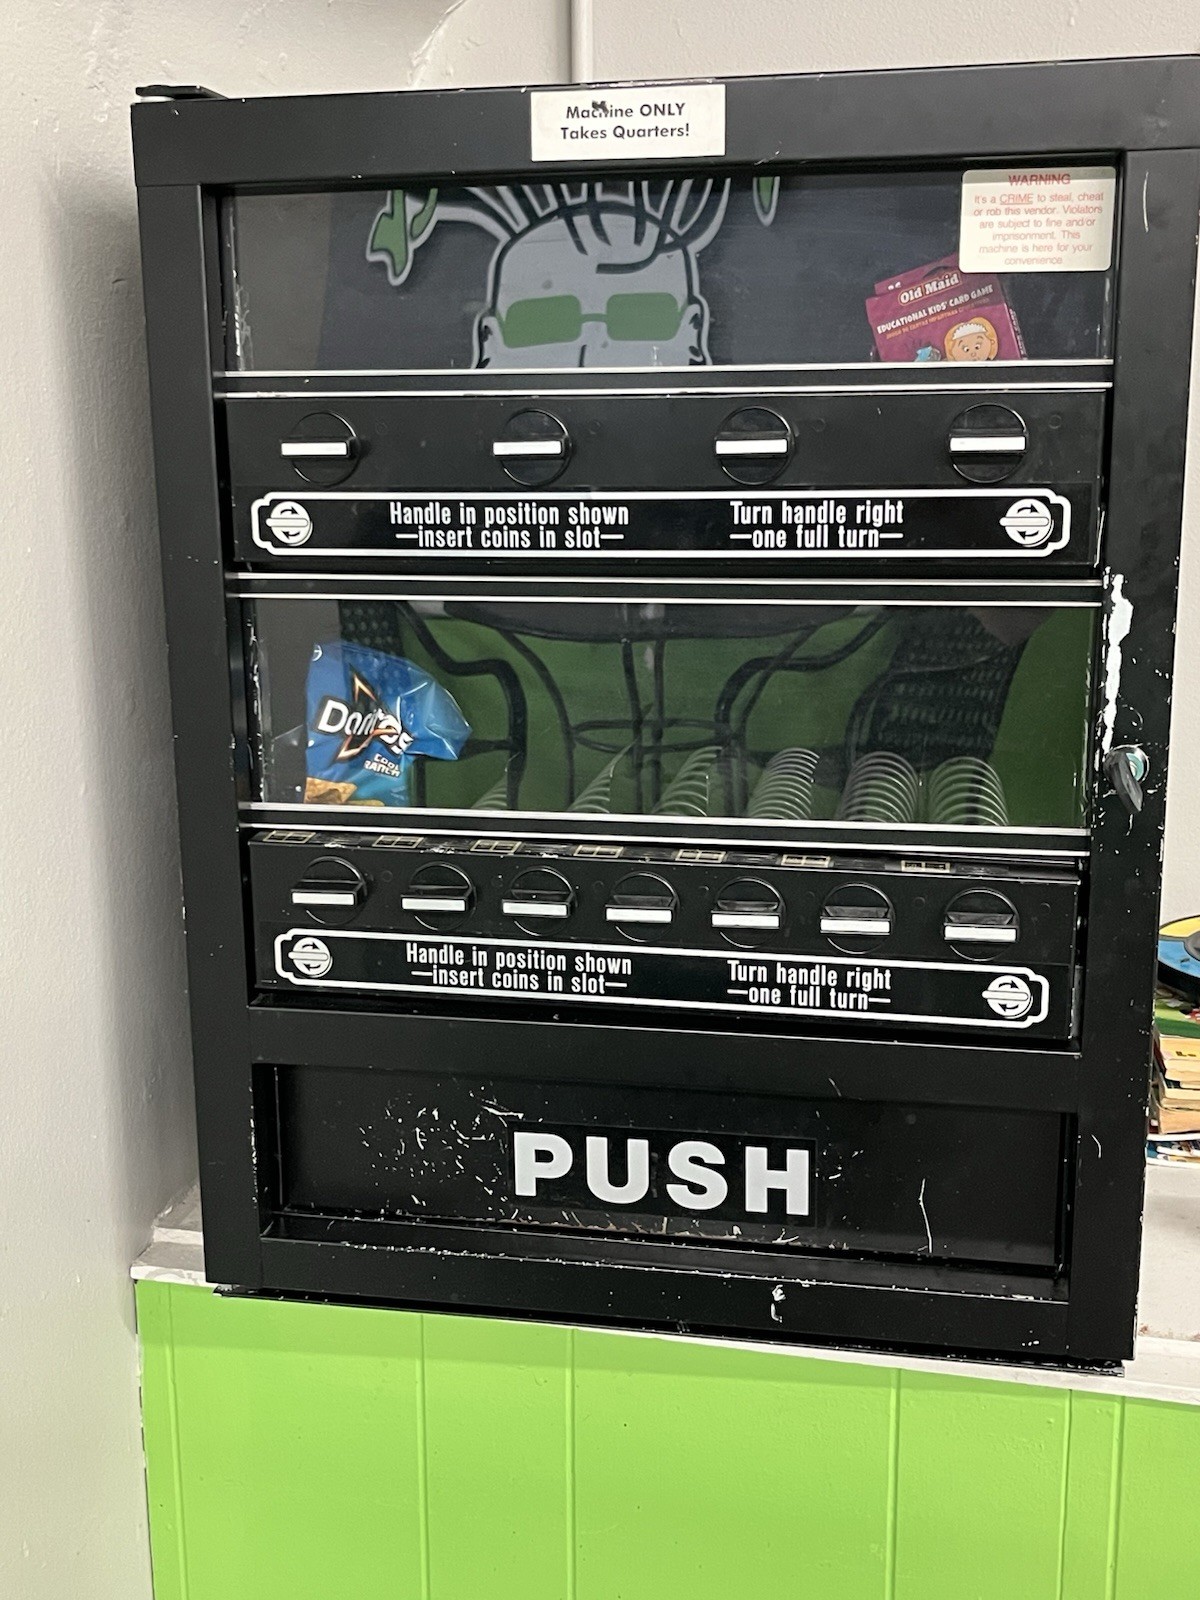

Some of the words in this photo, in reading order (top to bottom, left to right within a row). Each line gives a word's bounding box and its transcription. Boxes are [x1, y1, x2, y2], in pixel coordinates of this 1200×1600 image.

[640, 102, 686, 116] ONLY
[560, 126, 608, 140] Takes
[612, 123, 690, 139] Quarters!
[1008, 173, 1071, 186] WARNING
[975, 194, 988, 204] It's
[990, 196, 996, 204] a
[1000, 194, 1034, 204] CRIME
[1037, 194, 1046, 202] to
[1050, 193, 1073, 203] steal,
[1078, 192, 1104, 202] cheat
[974, 208, 982, 216] or
[986, 206, 1002, 216] rob
[1004, 206, 1020, 216] this
[1024, 206, 1058, 216] vendor.
[1062, 204, 1102, 214] Violators
[979, 220, 994, 229] are
[998, 218, 1030, 230] subject
[1034, 218, 1042, 228] to
[1046, 218, 1062, 227] fine
[1066, 218, 1096, 227] and/or
[1062, 230, 1081, 239] This
[979, 244, 1018, 254] machine
[1022, 244, 1029, 253] is
[1032, 243, 1054, 252] here
[1057, 242, 1069, 252] for
[1072, 243, 1094, 254] your
[900, 286, 923, 304] Old
[924, 274, 959, 296] Maid
[876, 310, 928, 334] EDUCATIONAL
[949, 294, 970, 308] CARD
[970, 284, 994, 300] GAME
[390, 502, 452, 526] Handle
[460, 502, 476, 525] in
[484, 502, 560, 531] position
[568, 502, 629, 526] shown
[729, 500, 772, 524] Turn
[782, 500, 846, 524] handle
[856, 500, 904, 528] right
[418, 525, 473, 548] insert
[480, 525, 532, 548] coins
[539, 525, 556, 548] in
[564, 525, 601, 548] slot
[752, 528, 786, 548] one
[796, 524, 828, 548] full
[838, 526, 880, 548] turn
[374, 754, 401, 771] COOL
[406, 942, 464, 966] Handle
[472, 946, 488, 968] in
[495, 948, 568, 975] position
[574, 952, 632, 976] shown
[432, 965, 484, 988] insert
[492, 968, 540, 992] coins
[547, 970, 564, 992] in
[571, 972, 606, 995] slot
[727, 959, 768, 983] Turn
[776, 962, 838, 987] handle
[846, 966, 892, 992] right
[748, 986, 781, 1006] one
[790, 984, 821, 1008] full
[830, 988, 869, 1010] turn
[513, 1131, 810, 1216] PUSH
